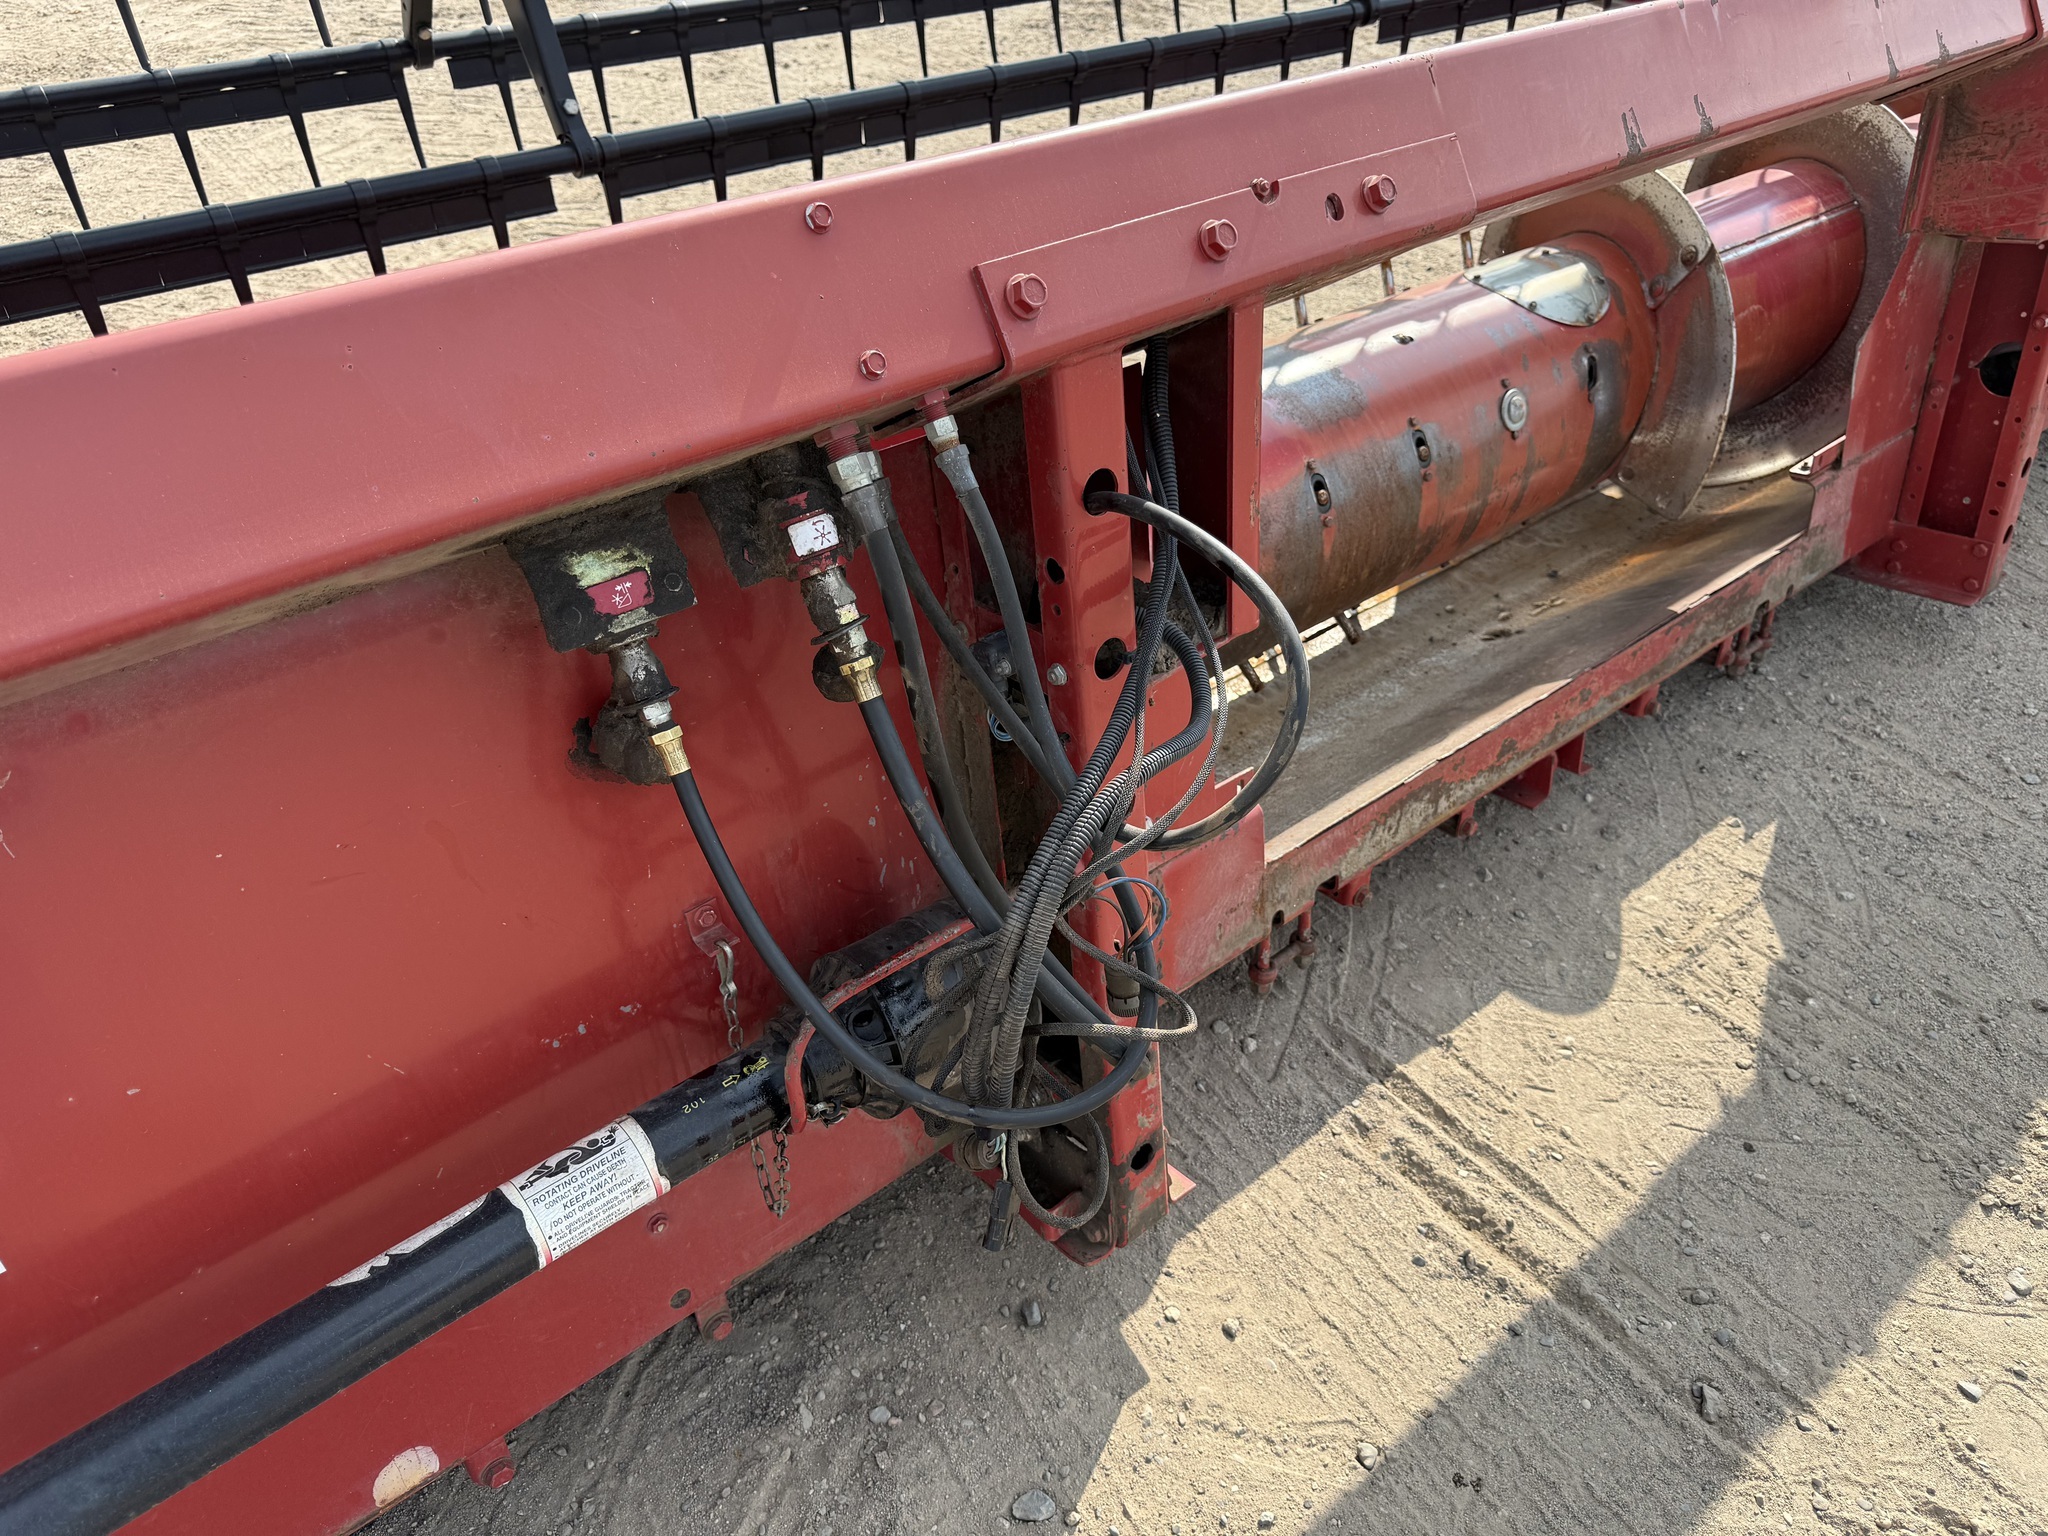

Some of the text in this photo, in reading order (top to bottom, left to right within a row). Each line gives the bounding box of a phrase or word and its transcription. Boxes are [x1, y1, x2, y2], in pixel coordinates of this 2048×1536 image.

[532, 1146, 626, 1206] ROTATING DRIVELINE
[544, 1158, 626, 1209] CONTACT CAN CAUSE DEATH
[553, 1218, 563, 1227] DO
[564, 1209, 577, 1220] NOT
[578, 1191, 608, 1212] OPERATE
[606, 1174, 635, 1195] WITHOUT
[563, 1173, 618, 1210] KEEP AWAY!
[554, 1228, 564, 1237] ALL
[565, 1210, 594, 1230] DRIVELINE
[556, 1232, 568, 1242] AND
[569, 1211, 602, 1235] EQUIPMENT
[602, 1198, 625, 1215] SHIELDS
[633, 1182, 650, 1196] PLACE
[558, 1226, 592, 1248] DRIVELINES
